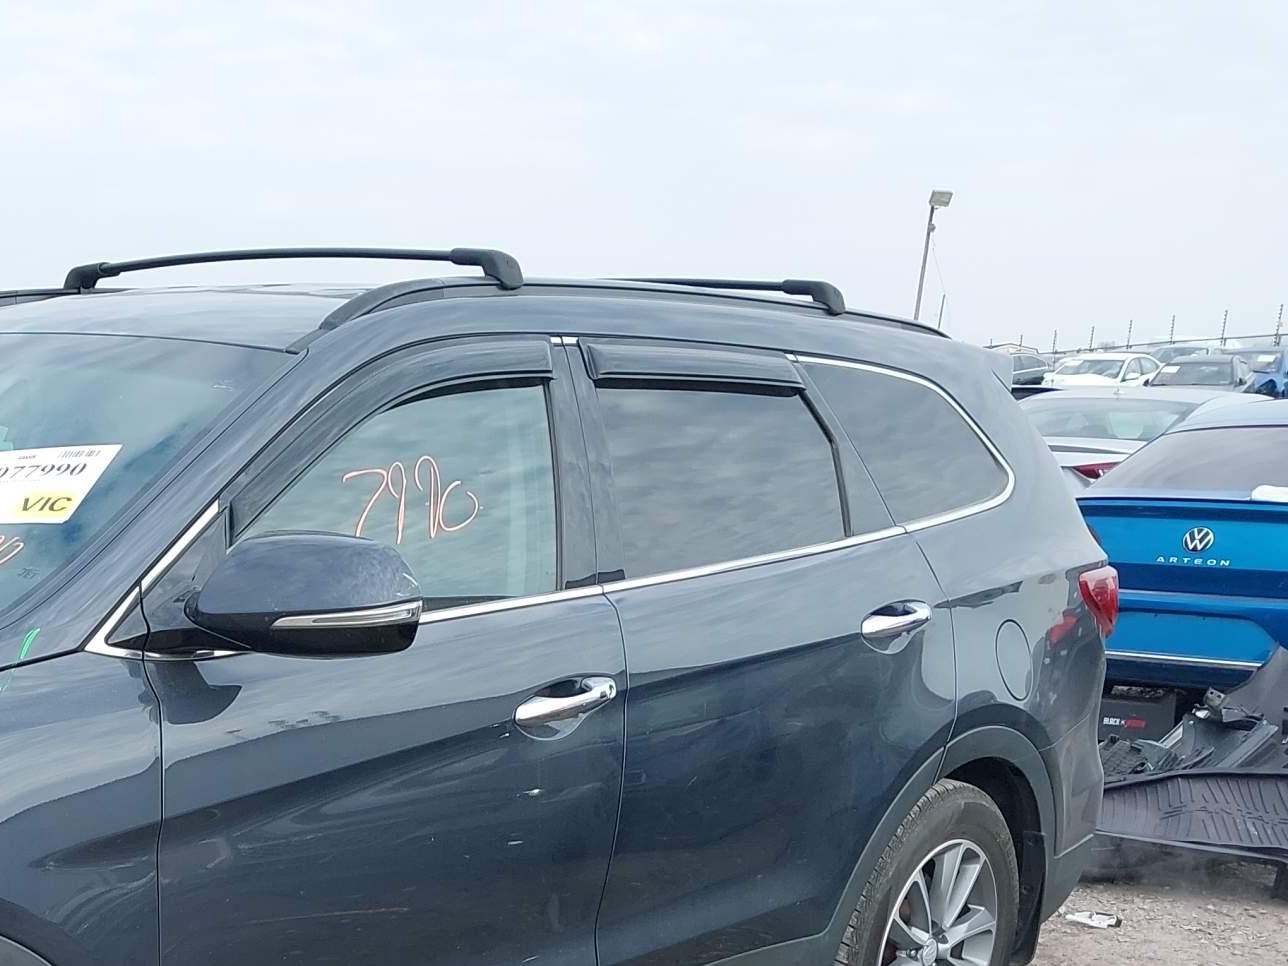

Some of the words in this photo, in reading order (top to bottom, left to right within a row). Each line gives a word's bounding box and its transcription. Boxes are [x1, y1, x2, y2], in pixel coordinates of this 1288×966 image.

[21, 496, 73, 512] VIC
[342, 455, 479, 545] 7990
[1156, 556, 1231, 567] ARTEON
